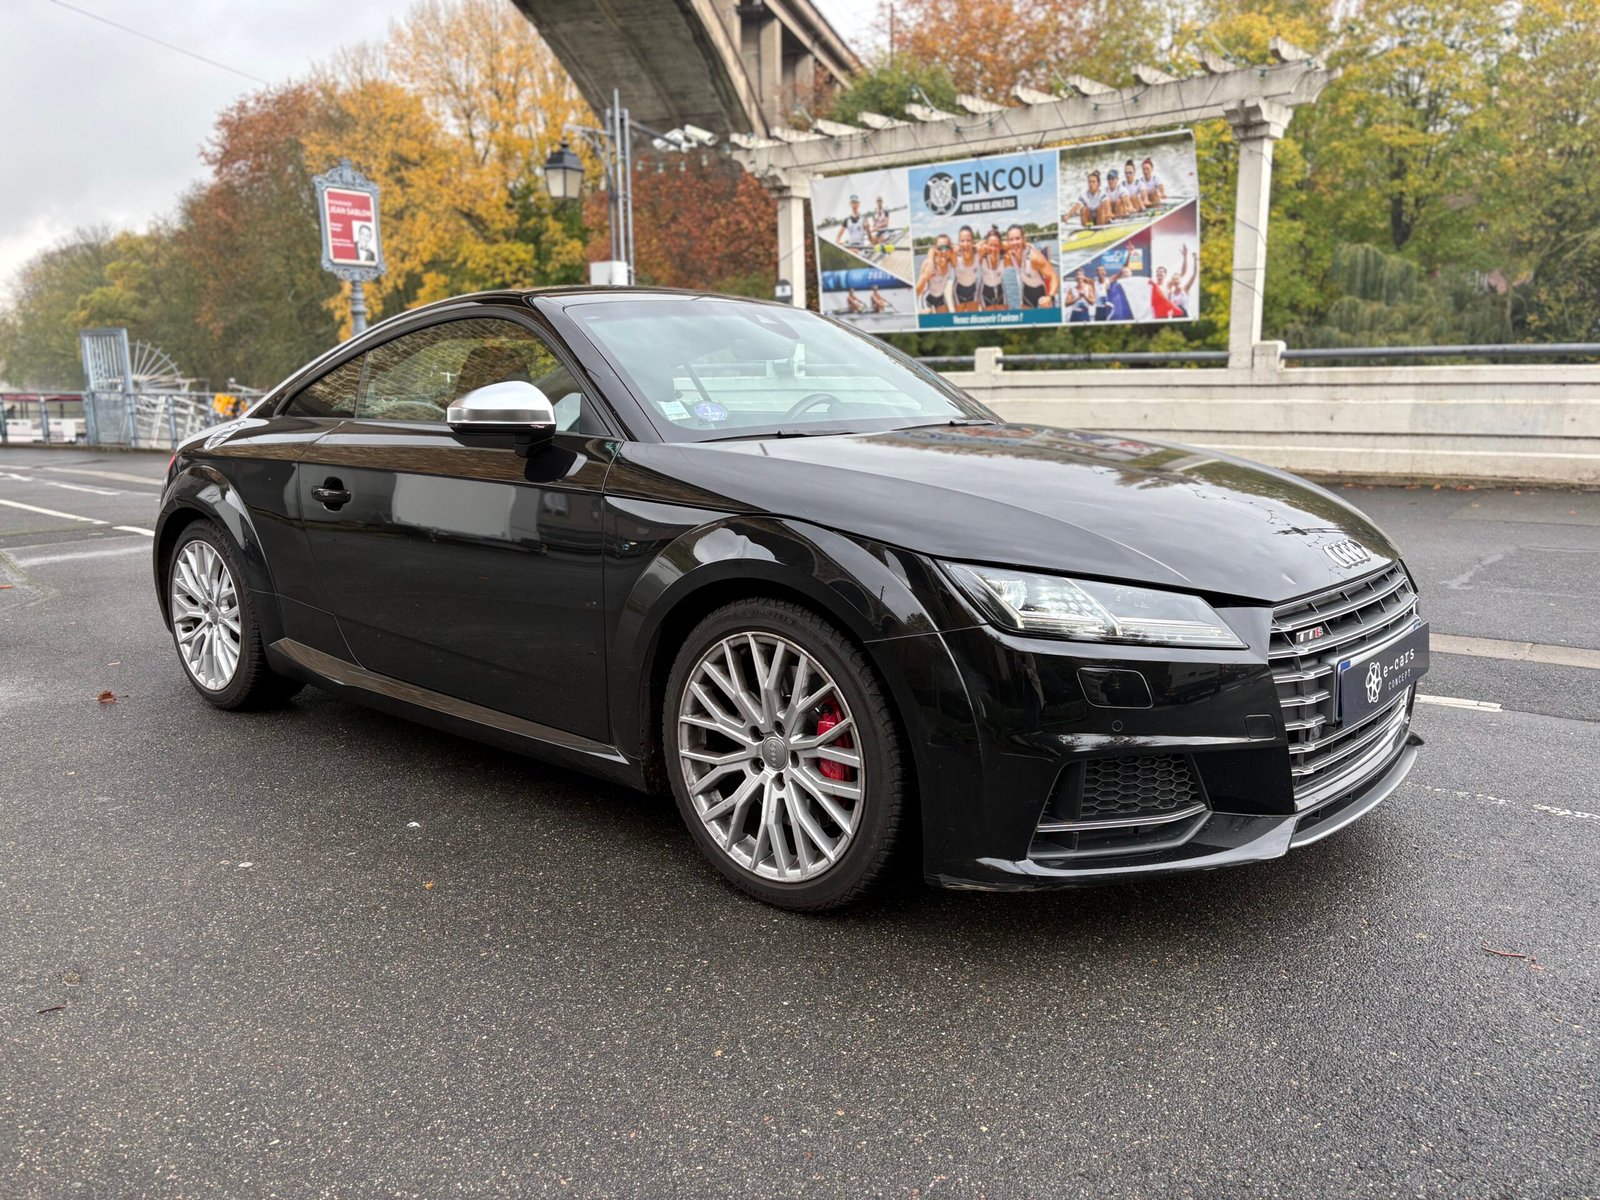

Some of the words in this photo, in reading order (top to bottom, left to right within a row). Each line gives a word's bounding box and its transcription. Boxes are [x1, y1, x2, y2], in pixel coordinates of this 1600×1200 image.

[960, 164, 1043, 195] ENCOU
[1383, 648, 1415, 678] e-cars
[1388, 668, 1411, 690] CONCEPT
